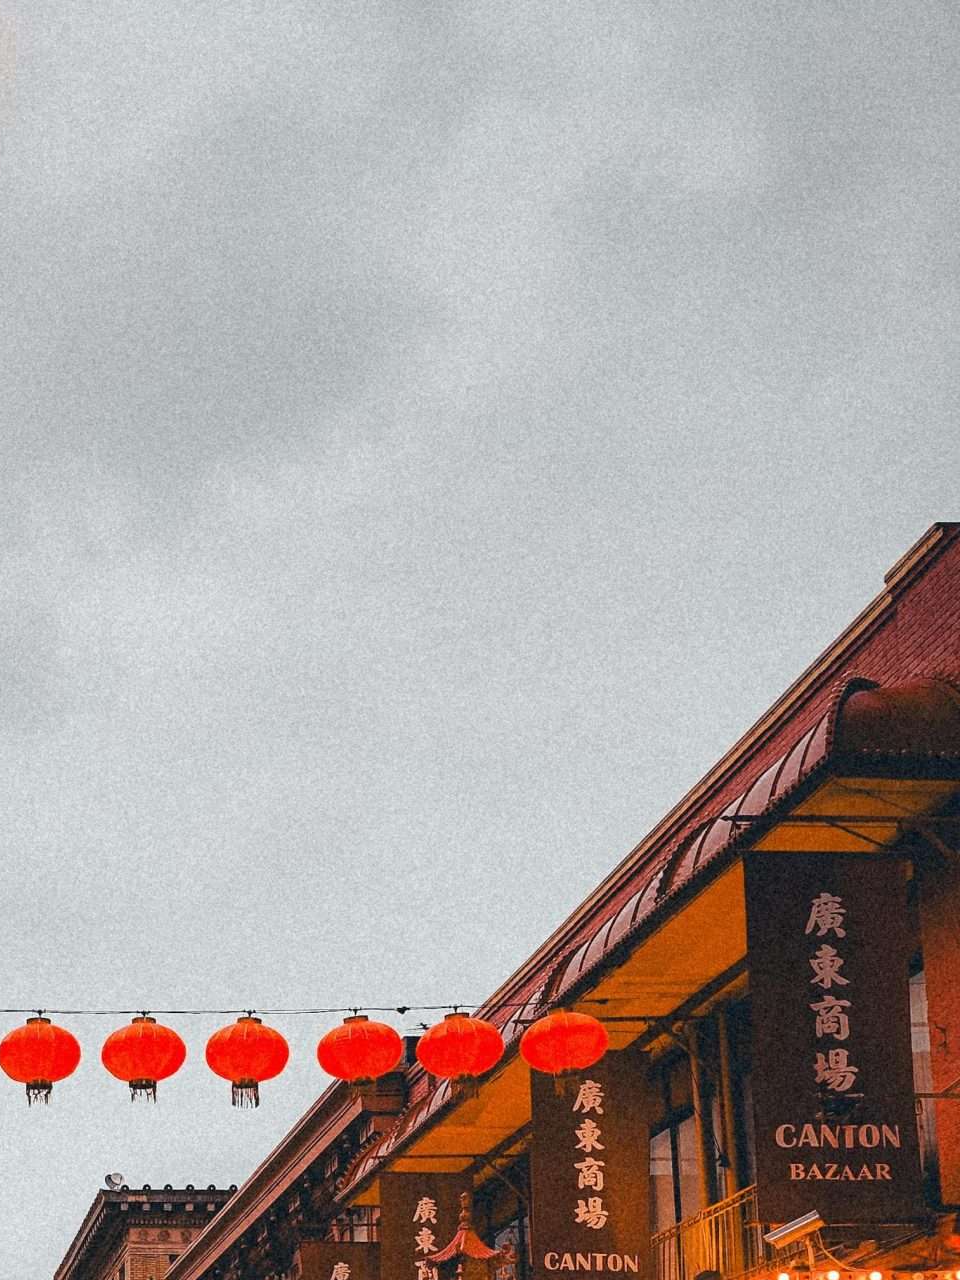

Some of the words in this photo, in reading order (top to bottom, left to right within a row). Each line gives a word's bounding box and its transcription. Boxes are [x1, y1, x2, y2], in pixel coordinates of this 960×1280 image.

[804, 892, 859, 1092] 廣東商場
[775, 1123, 901, 1149] CANTON
[572, 1079, 609, 1230] 廣東商場
[789, 1162, 893, 1181] BAZAAR
[543, 1251, 640, 1273] CANTON
